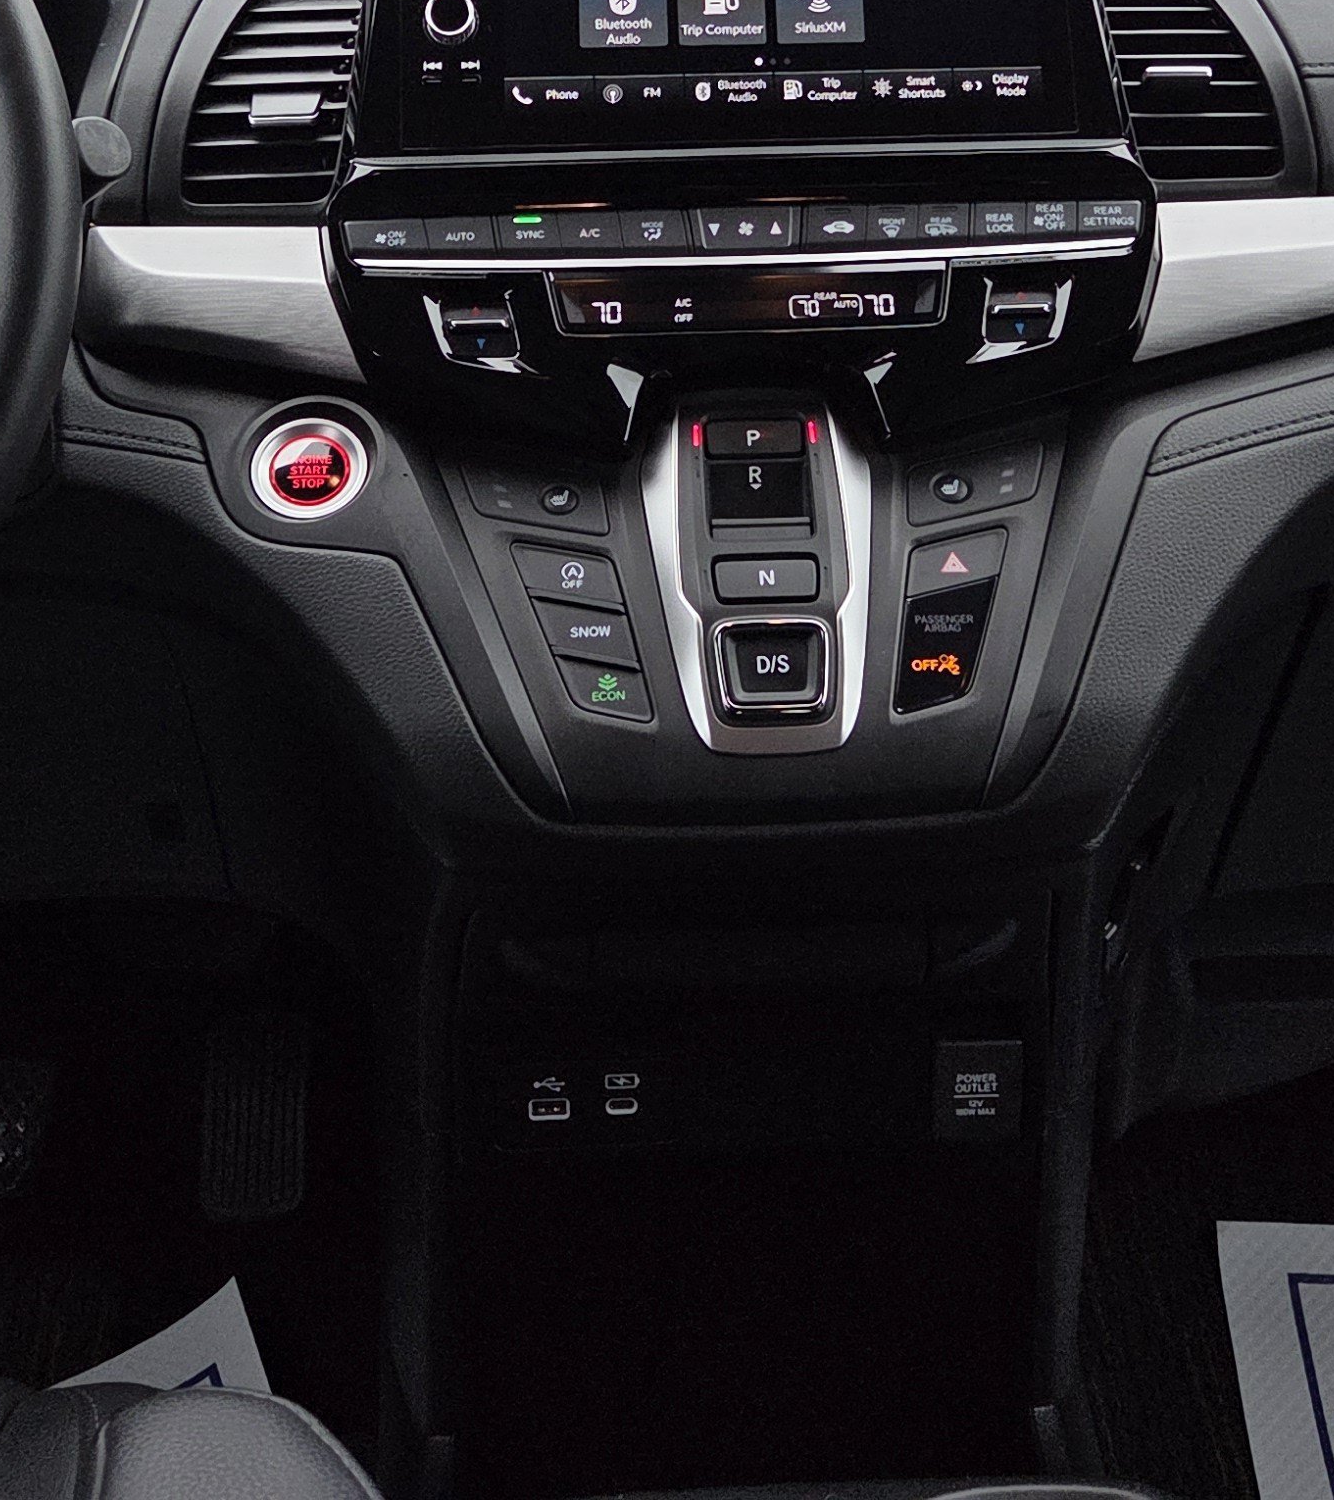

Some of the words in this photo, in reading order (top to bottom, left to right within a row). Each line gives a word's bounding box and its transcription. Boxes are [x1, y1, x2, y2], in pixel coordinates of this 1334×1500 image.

[594, 17, 653, 30] Bluetooth
[794, 21, 846, 34] SiriusXM
[680, 24, 704, 37] Trip
[705, 23, 764, 37] Computer
[605, 33, 642, 46] Audio
[717, 79, 767, 91] Bluetooth
[821, 77, 842, 90] Trip
[905, 75, 936, 87] Smart
[992, 73, 1029, 86] Display
[545, 89, 580, 100] Phone
[643, 86, 662, 98] FM
[727, 91, 758, 103] Audio
[807, 89, 858, 102] Computer
[897, 87, 946, 99] Shortcuts
[996, 85, 1027, 97] Mode
[1035, 203, 1064, 214] REAR
[1093, 205, 1122, 216] REAR
[878, 217, 906, 226] FRONT
[985, 212, 1014, 223] REAR
[1083, 216, 1135, 227] SETTINGS
[641, 221, 664, 229] MODE
[986, 222, 1015, 233] LOCK
[1045, 221, 1066, 231] OFF
[445, 231, 476, 242] AUTO
[515, 229, 546, 240] SYNC
[579, 228, 601, 239] A/C
[387, 238, 407, 247] OFF
[674, 298, 692, 308] A/C
[833, 299, 859, 309] AUTO
[746, 429, 761, 446] P
[291, 454, 333, 465] NGINE
[289, 465, 329, 475] START
[748, 465, 762, 483] R
[292, 478, 325, 489] STOP
[758, 569, 776, 586] N
[561, 579, 583, 590] OFF
[914, 613, 974, 626] PASSENGER
[569, 625, 611, 638] SNOW
[923, 622, 962, 634] AIRBAG
[755, 654, 790, 675] D/S
[911, 659, 940, 671] OFF
[591, 689, 626, 702] ECON
[956, 1072, 997, 1083] POWER
[954, 1082, 999, 1093] OUTLET
